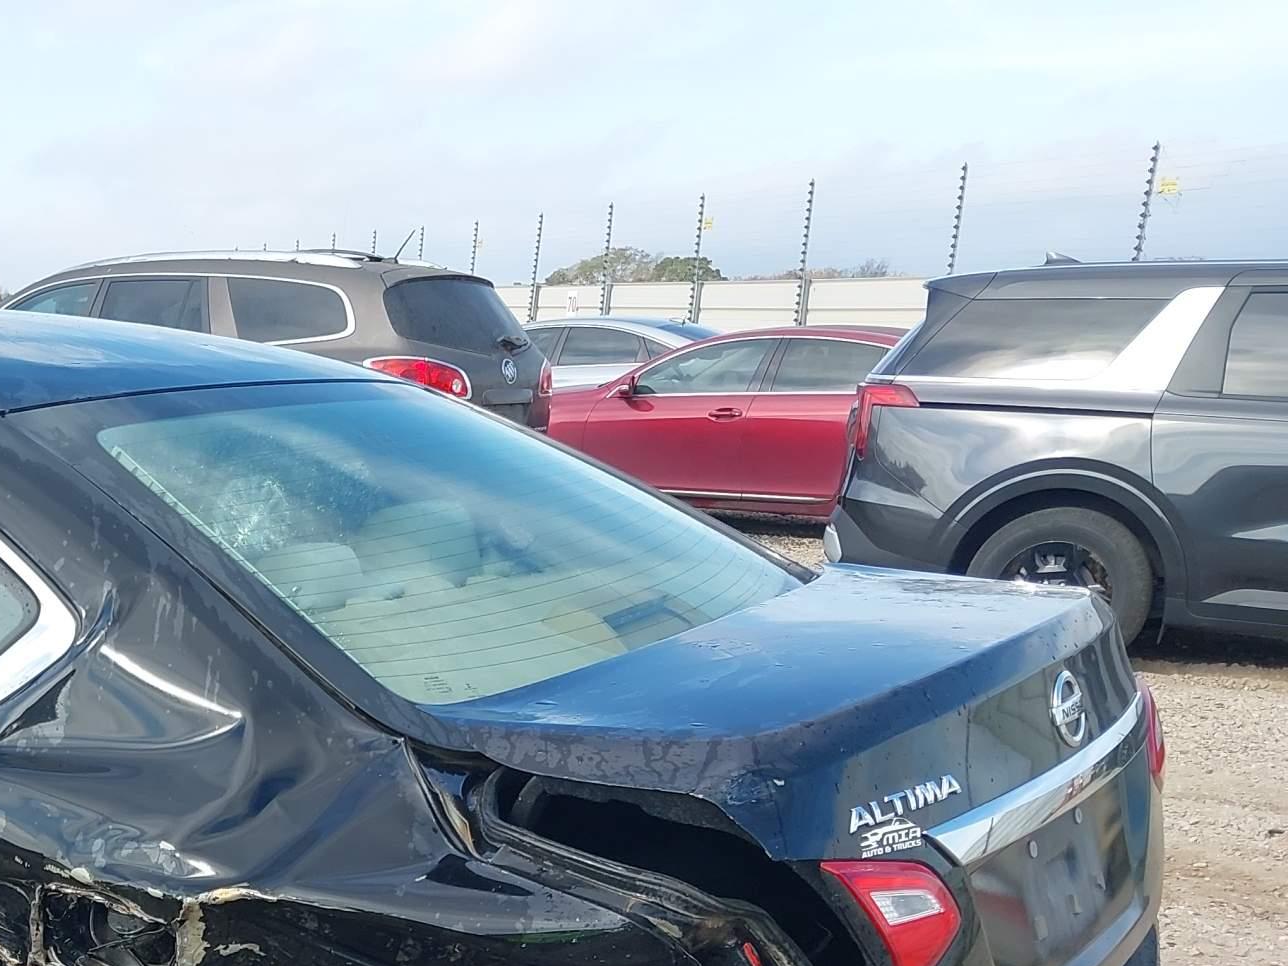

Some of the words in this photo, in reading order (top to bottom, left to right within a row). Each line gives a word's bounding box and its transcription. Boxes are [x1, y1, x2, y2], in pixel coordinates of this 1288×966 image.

[849, 774, 962, 834] ALTIMA
[883, 827, 921, 845] MIA
[861, 847, 884, 859] AUTO
[885, 846, 892, 854] &
[893, 839, 922, 852] TRUCKS
